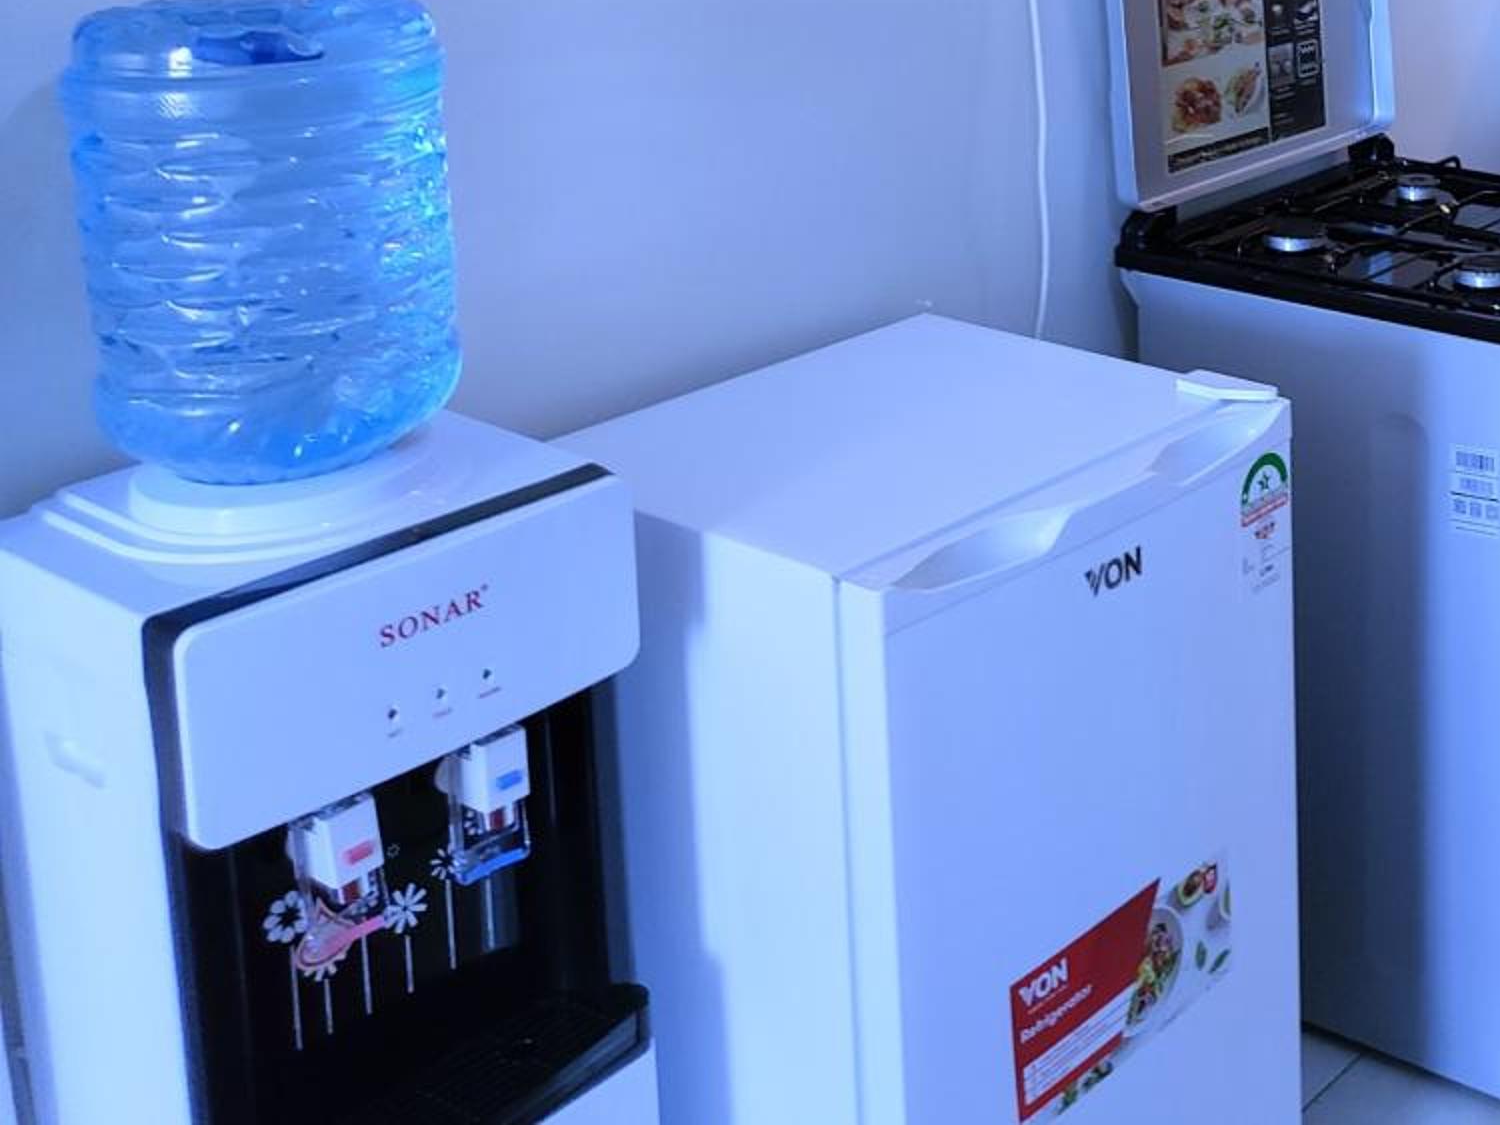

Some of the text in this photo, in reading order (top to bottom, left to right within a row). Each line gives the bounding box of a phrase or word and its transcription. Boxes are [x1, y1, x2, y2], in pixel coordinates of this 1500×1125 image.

[1084, 545, 1142, 596] VON
[379, 588, 484, 649] SONAR
[1018, 957, 1068, 1006] VON
